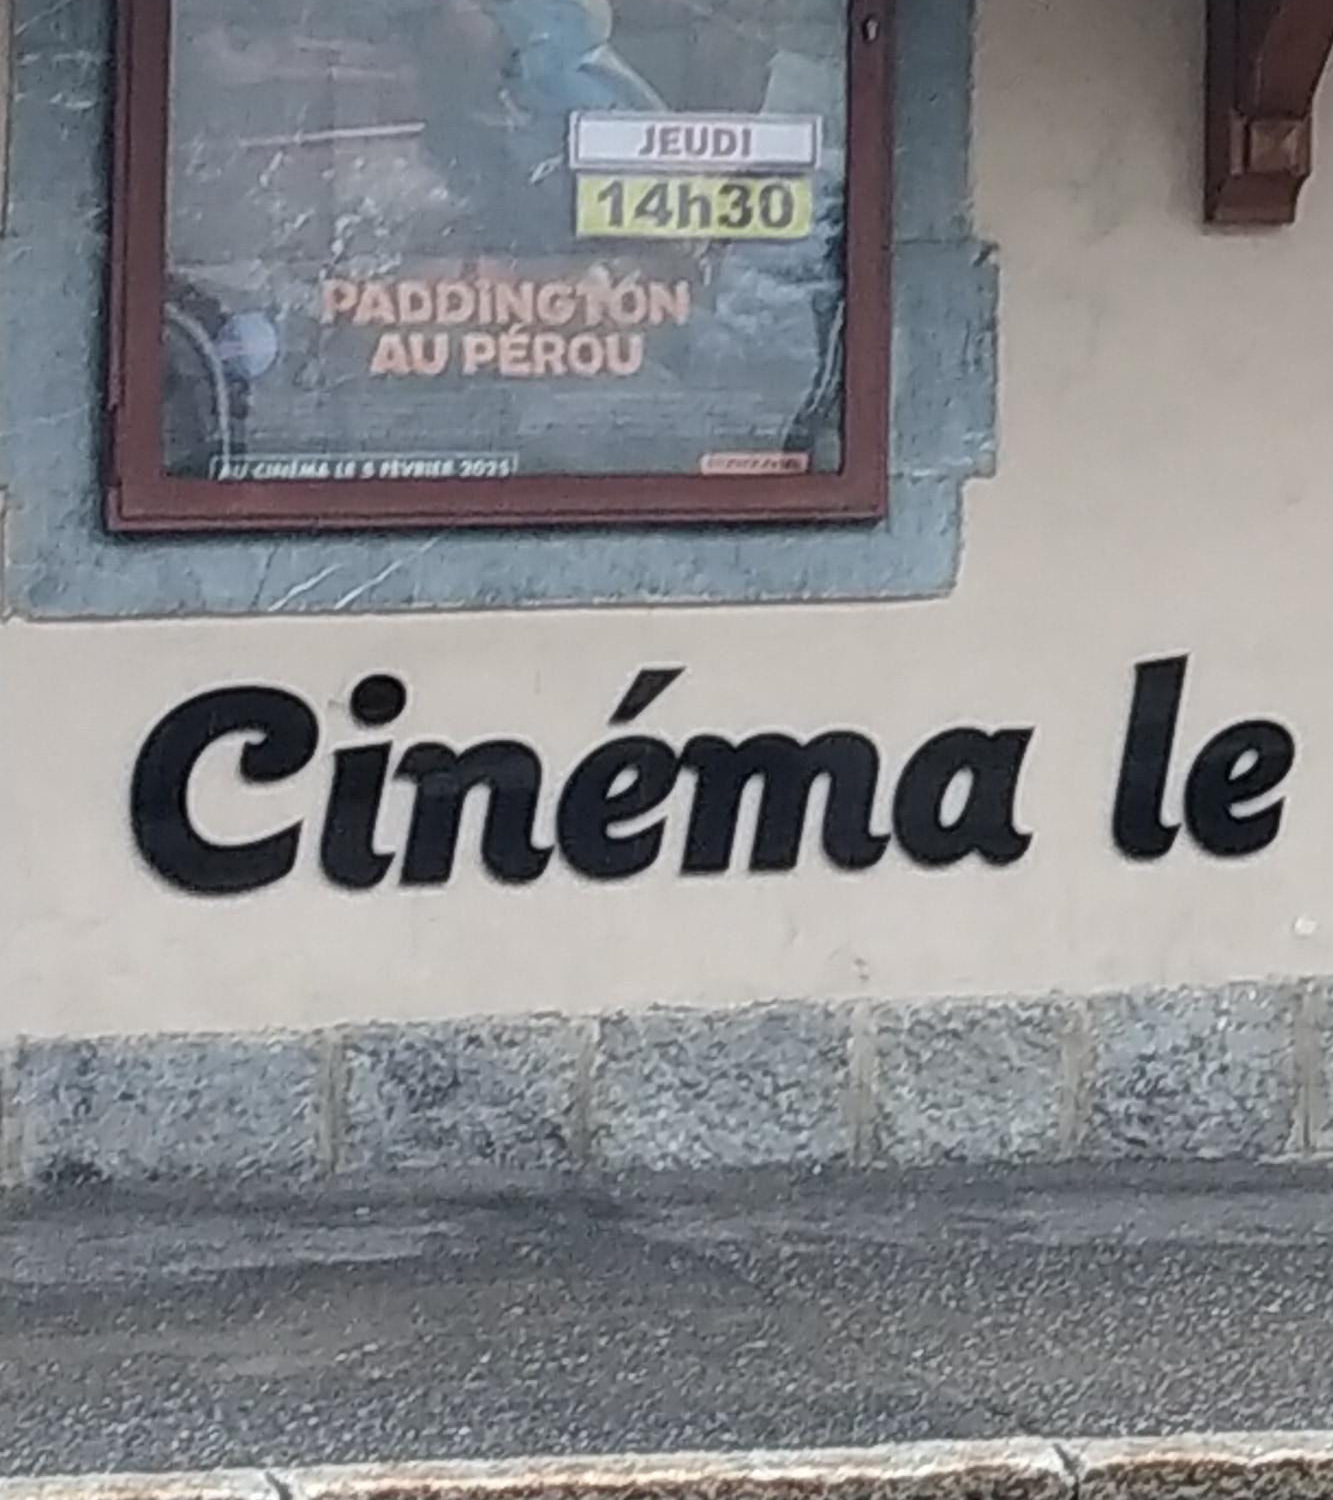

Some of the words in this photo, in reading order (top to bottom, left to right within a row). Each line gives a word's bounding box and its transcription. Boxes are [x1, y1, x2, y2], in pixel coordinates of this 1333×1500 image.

[638, 125, 752, 158] JEUDI
[596, 180, 795, 230] 14h30
[319, 279, 690, 326] PADDINGTON
[370, 331, 450, 376] AU
[462, 323, 643, 377] PÉROU
[131, 668, 1032, 895] Cinéma
[1111, 657, 1295, 862] le
